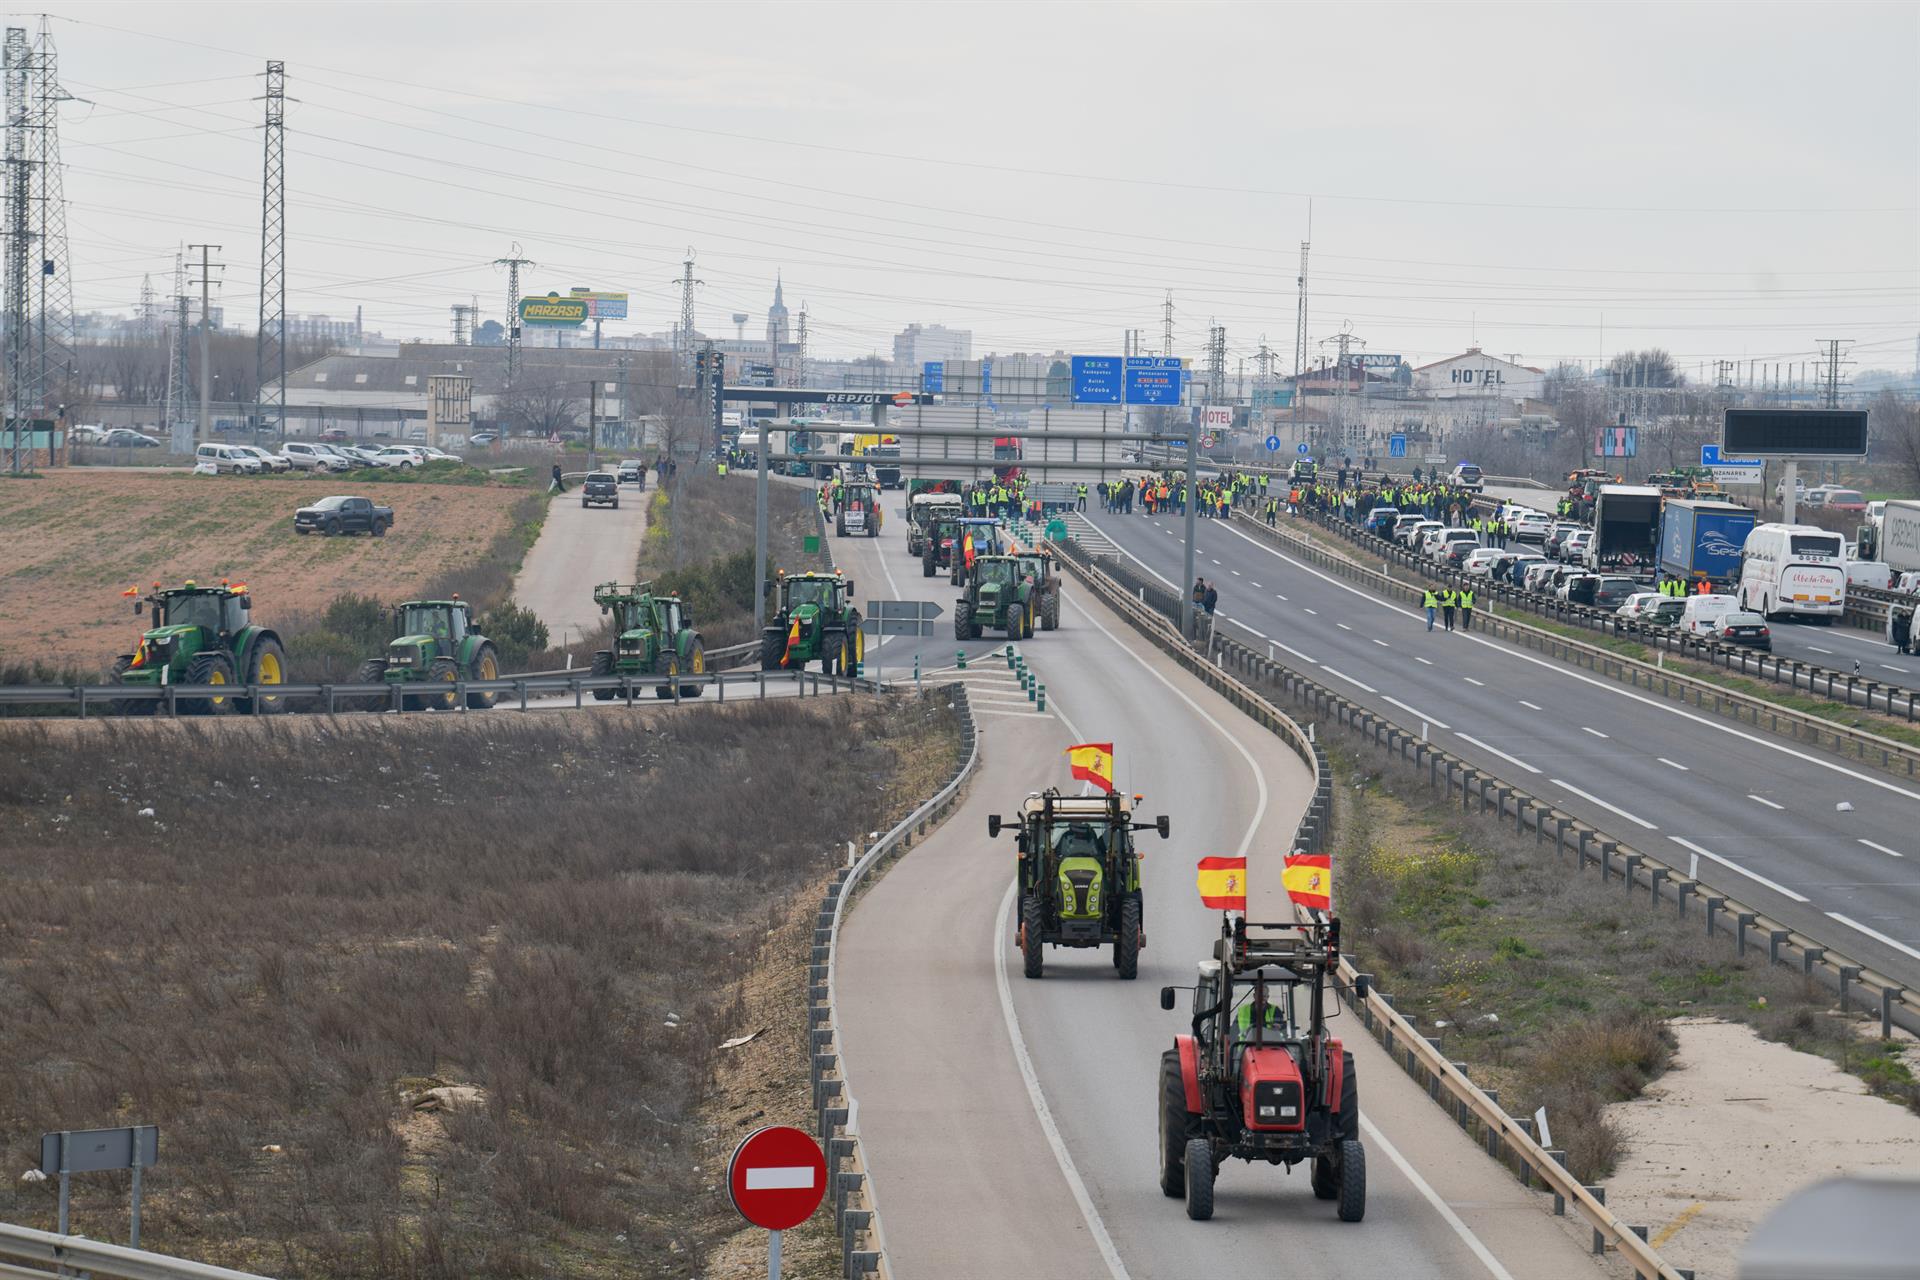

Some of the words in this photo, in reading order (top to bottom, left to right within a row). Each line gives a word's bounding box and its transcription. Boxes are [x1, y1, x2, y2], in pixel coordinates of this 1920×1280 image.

[524, 305, 582, 317] MARZASA
[1451, 369, 1505, 384] HOTEL
[826, 393, 881, 404] REPSOL
